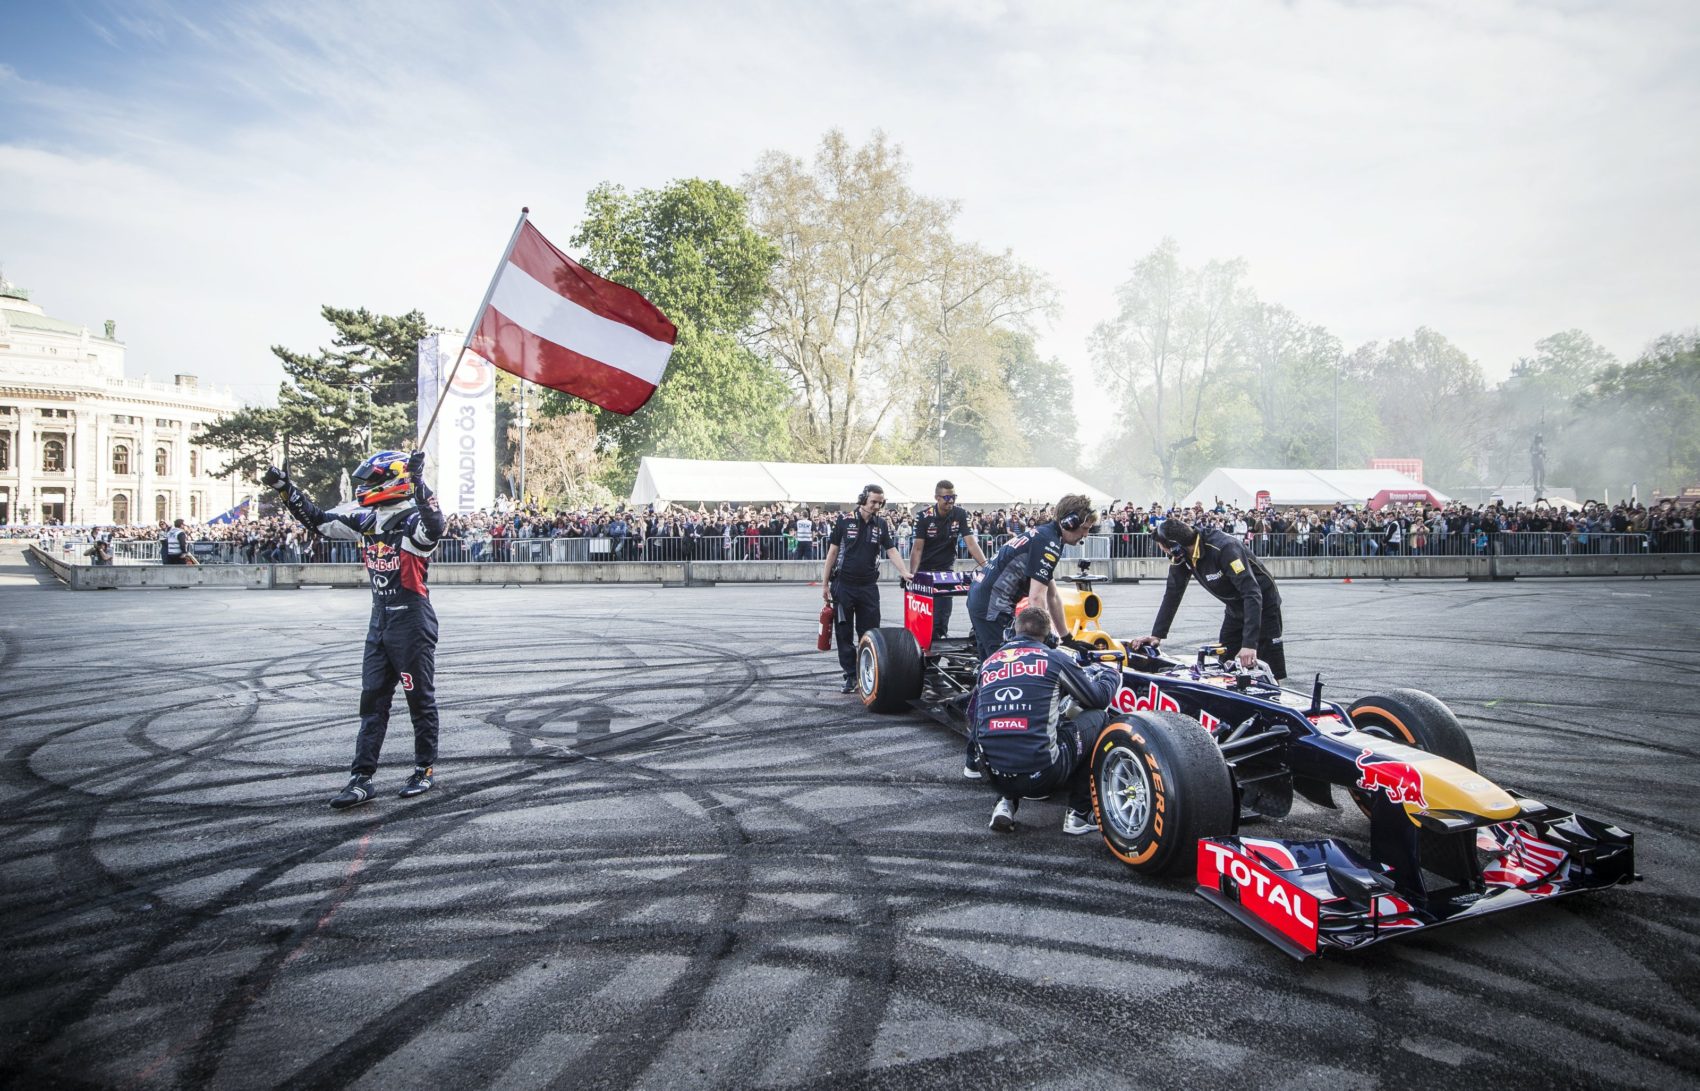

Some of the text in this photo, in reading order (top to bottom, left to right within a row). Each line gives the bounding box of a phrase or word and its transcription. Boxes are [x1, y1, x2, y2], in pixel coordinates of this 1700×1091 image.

[455, 404, 476, 431] Ö3
[906, 595, 932, 616] TOTAL
[400, 672, 414, 691] 3
[981, 659, 1048, 688] Red Bull
[987, 703, 1032, 713] INFINITI
[991, 720, 1025, 729] TOTAL
[1144, 753, 1166, 837] ZERO
[1205, 843, 1314, 930] TOTAL
